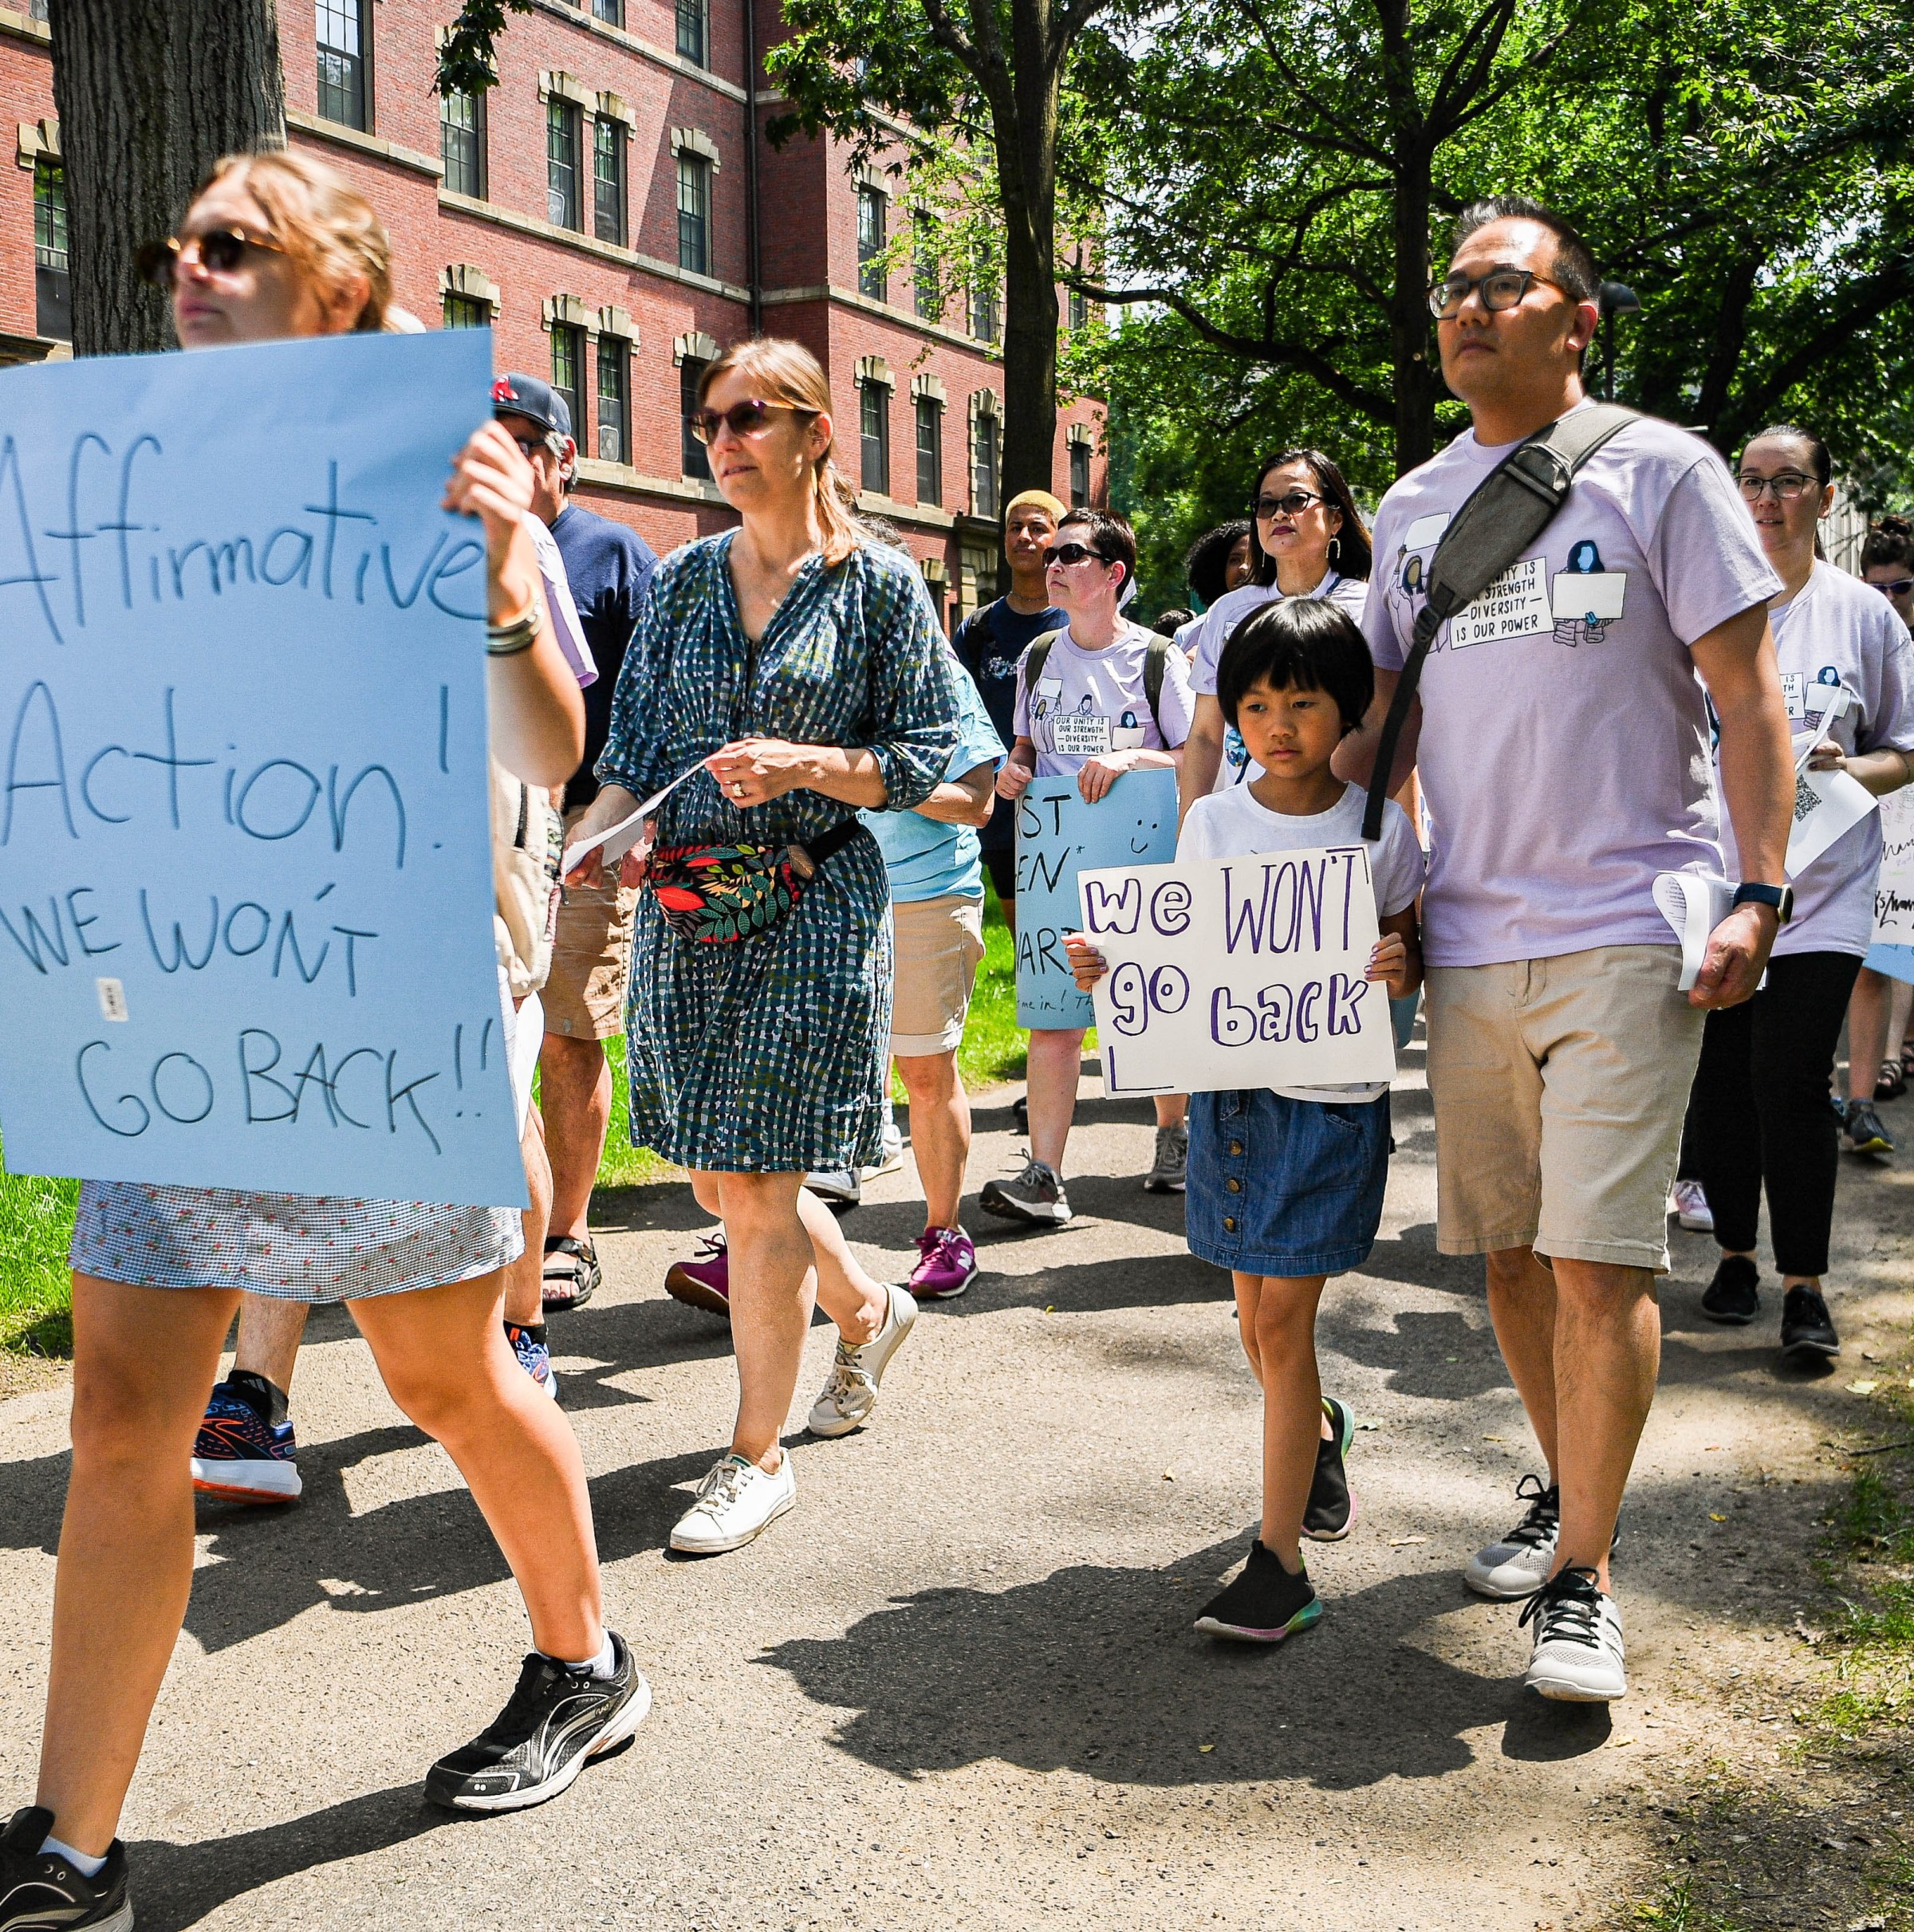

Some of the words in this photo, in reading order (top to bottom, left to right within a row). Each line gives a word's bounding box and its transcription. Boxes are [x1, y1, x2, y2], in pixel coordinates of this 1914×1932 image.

[0, 432, 487, 644] Affirmative
[1525, 561, 1535, 576] IS
[1456, 626, 1467, 642] IS
[1474, 622, 1495, 639] OUR
[1501, 614, 1538, 634] POWER
[1470, 596, 1526, 620] DIVERSITY
[1484, 577, 1535, 600] STRENGTH
[2, 680, 455, 870] Action!
[1082, 745, 1105, 754] POWER
[0, 887, 122, 974] WE
[140, 883, 379, 997] WON'T
[1085, 878, 1192, 936] we
[1220, 854, 1356, 954] WON'T
[1110, 962, 1190, 1037] go
[1211, 973, 1369, 1047] back
[78, 1040, 215, 1137] GO
